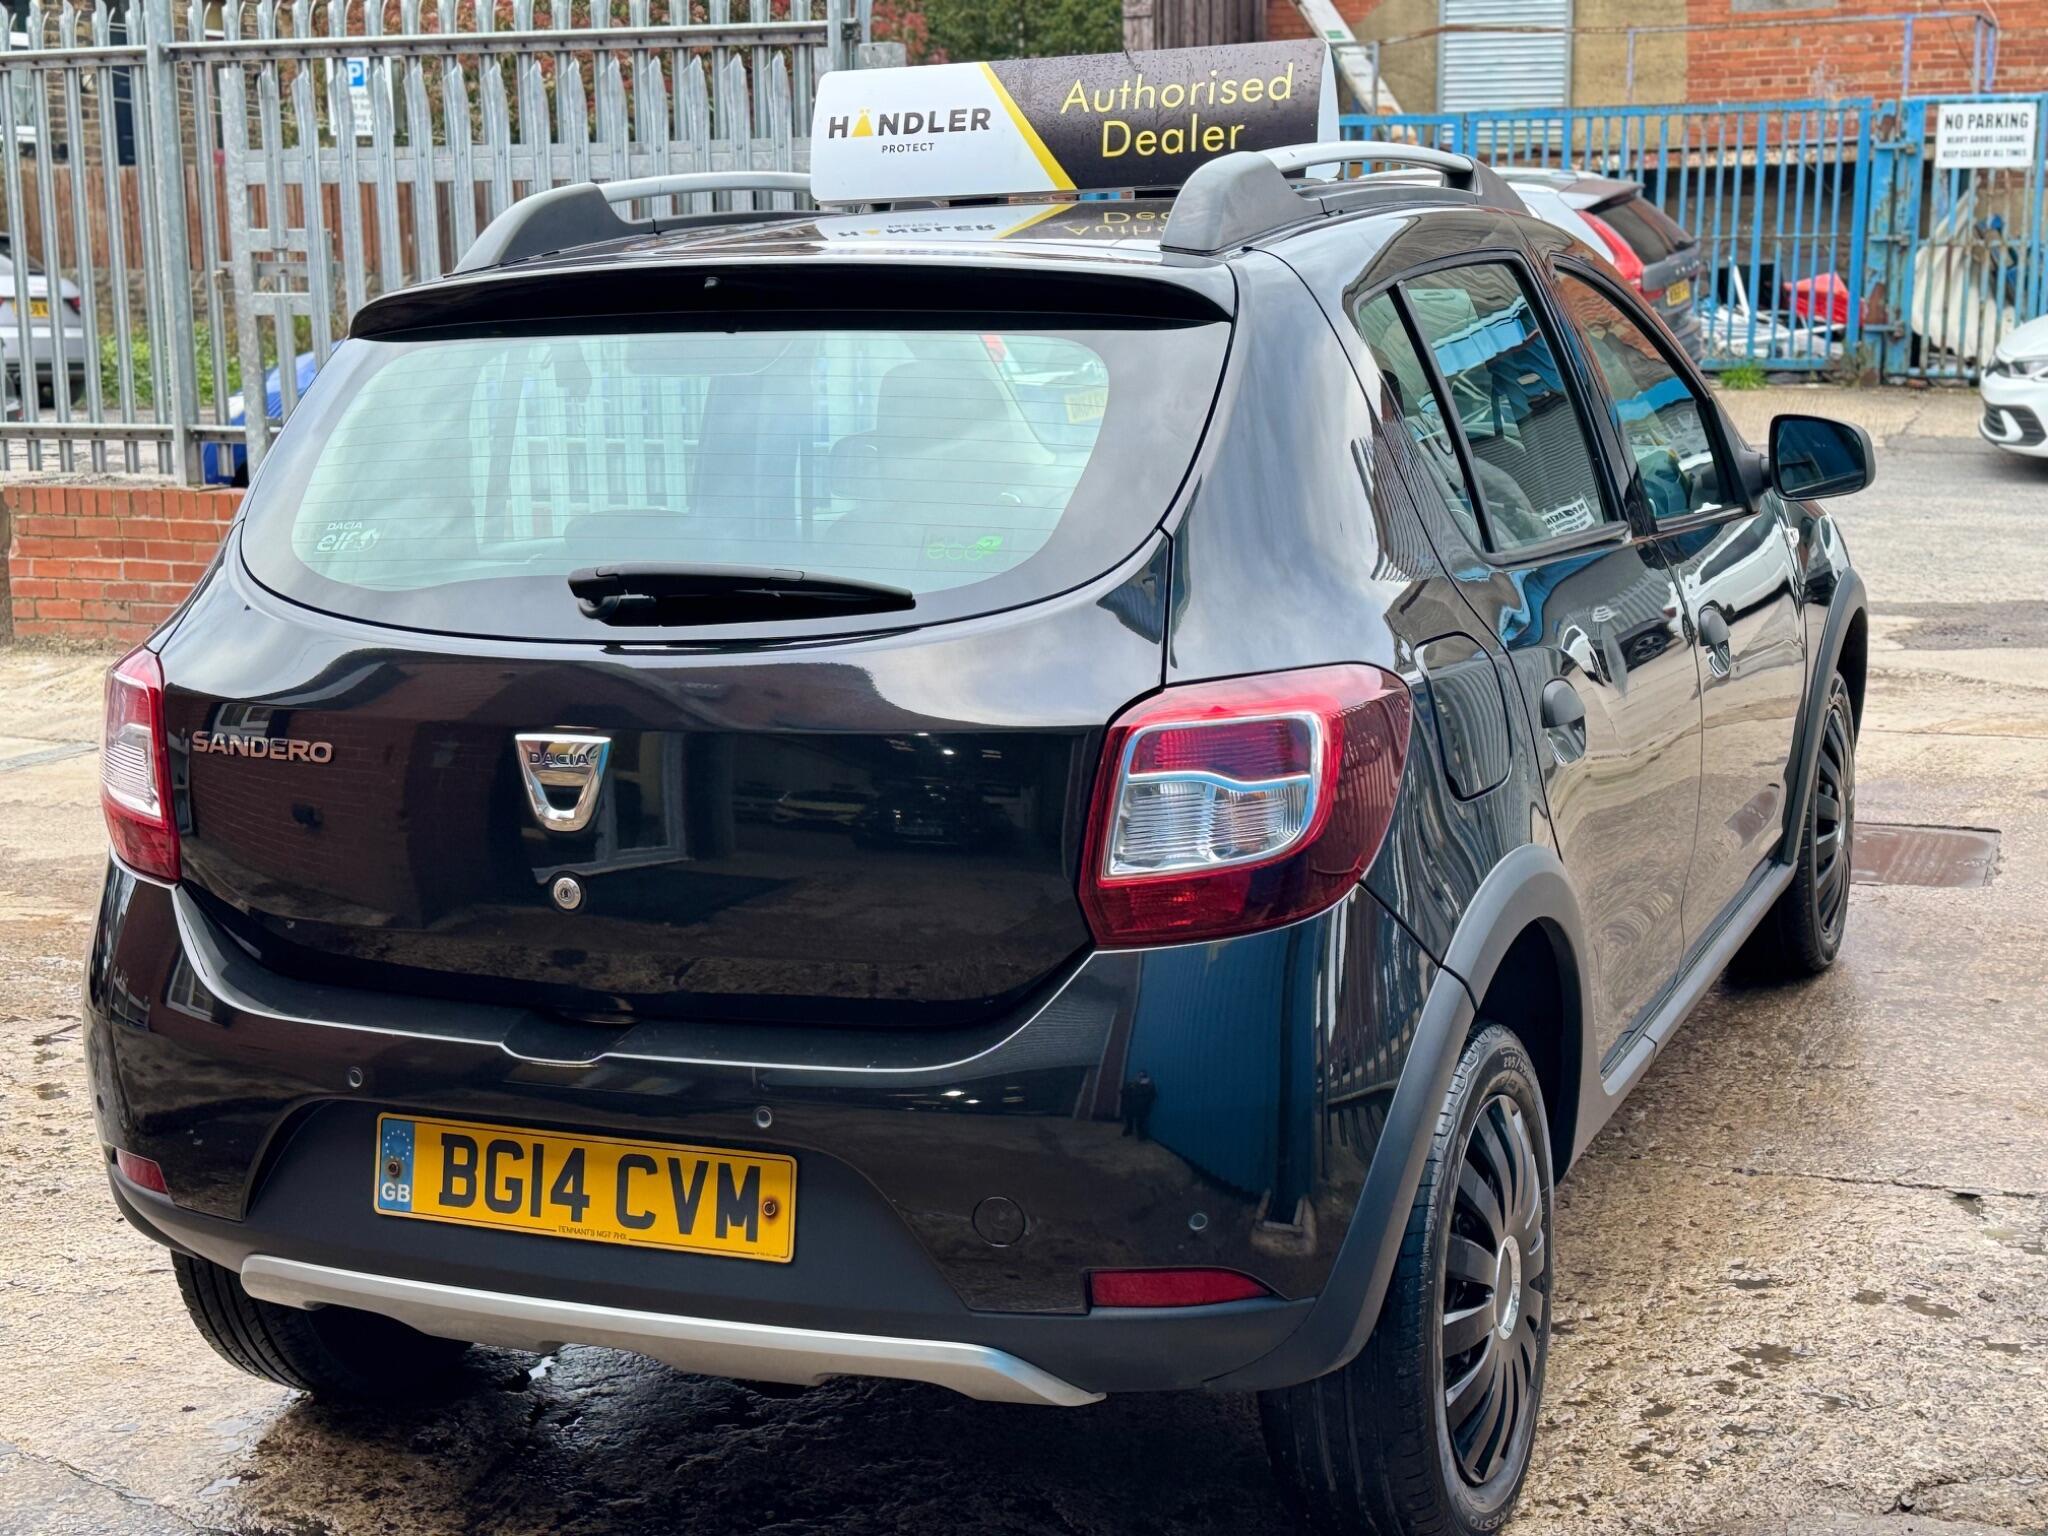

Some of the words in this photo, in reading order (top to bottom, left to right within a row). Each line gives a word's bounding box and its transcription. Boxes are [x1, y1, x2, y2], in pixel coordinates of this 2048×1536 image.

[1061, 62, 1295, 115] Authorised
[1944, 113, 1964, 130] NO
[1968, 112, 2029, 129] PARKING
[1101, 113, 1245, 158] Dealer
[881, 142, 935, 153] PROTECT
[327, 521, 363, 531] DACIA
[192, 730, 334, 764] SANDERO
[529, 752, 590, 766] DACIA
[380, 1181, 411, 1203] GB
[438, 1132, 591, 1223] BG14
[615, 1153, 762, 1243] CVM
